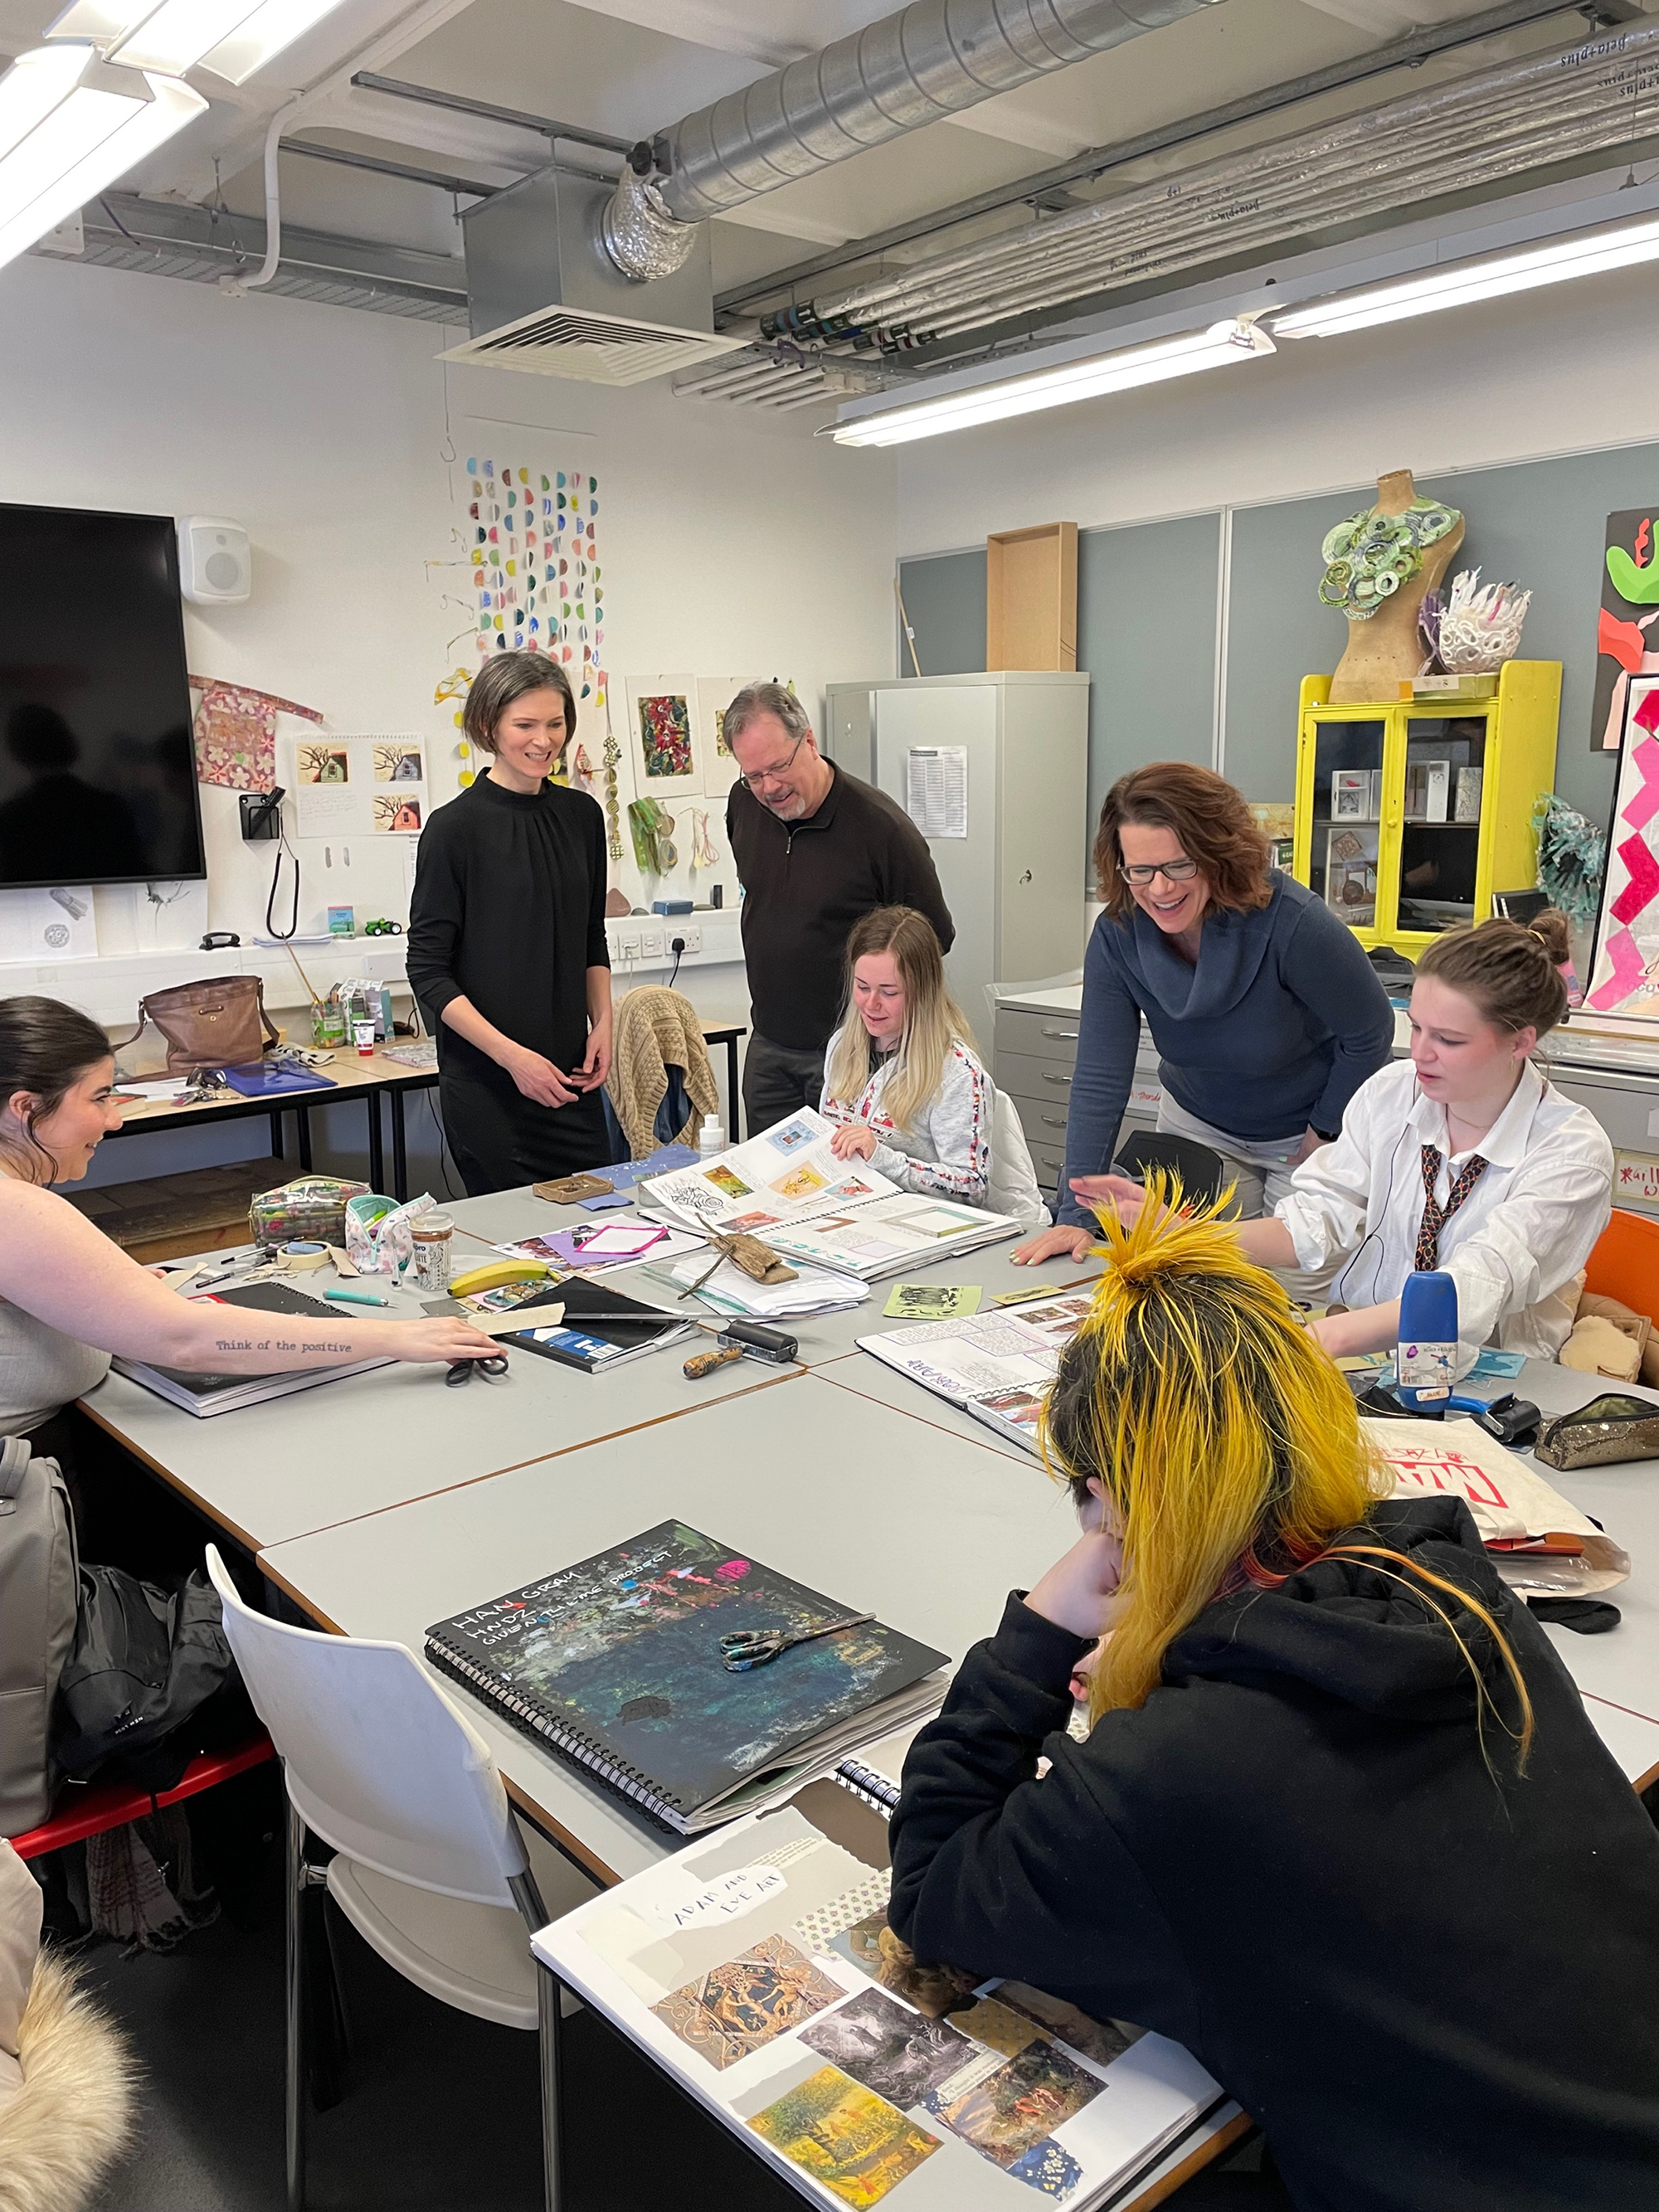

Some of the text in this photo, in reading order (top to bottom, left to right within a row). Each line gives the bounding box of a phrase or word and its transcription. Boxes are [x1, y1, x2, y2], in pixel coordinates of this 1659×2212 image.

[216, 1339, 252, 1351] Think
[257, 1340, 271, 1350] of
[276, 1340, 296, 1351] the
[451, 1600, 514, 1630] HAN
[482, 1618, 538, 1646] GIVEN
[609, 1551, 673, 1585] PROJECT
[674, 1874, 747, 1925] ADAM AND
[720, 1874, 780, 1913] EVE ART
